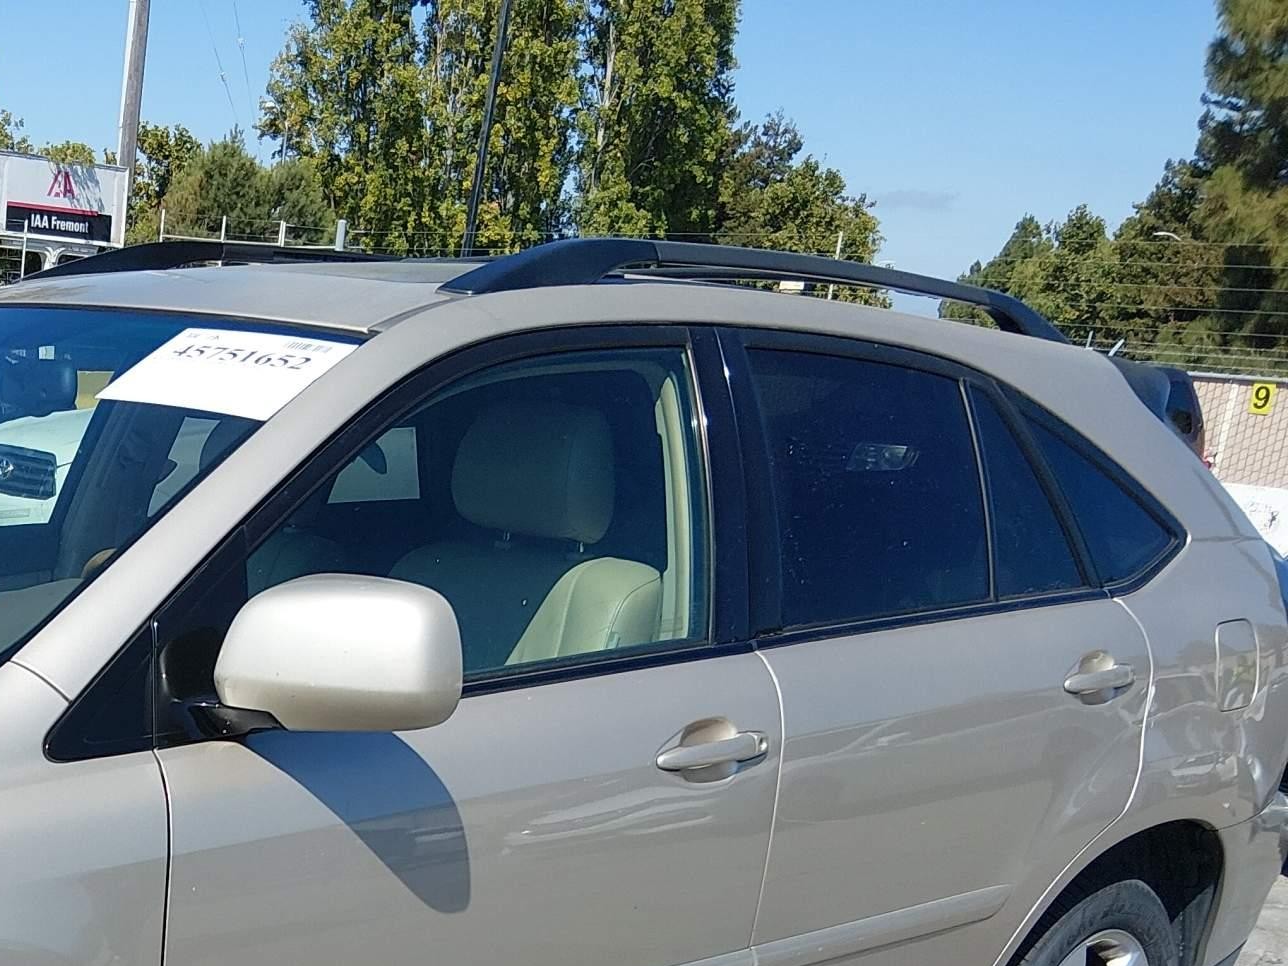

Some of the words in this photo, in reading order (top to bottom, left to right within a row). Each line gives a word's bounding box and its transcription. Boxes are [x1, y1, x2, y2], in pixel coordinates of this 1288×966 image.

[30, 213, 49, 229] IAA
[51, 215, 89, 233] Fremont
[172, 344, 312, 370] 45751652
[1253, 386, 1271, 409] 9
